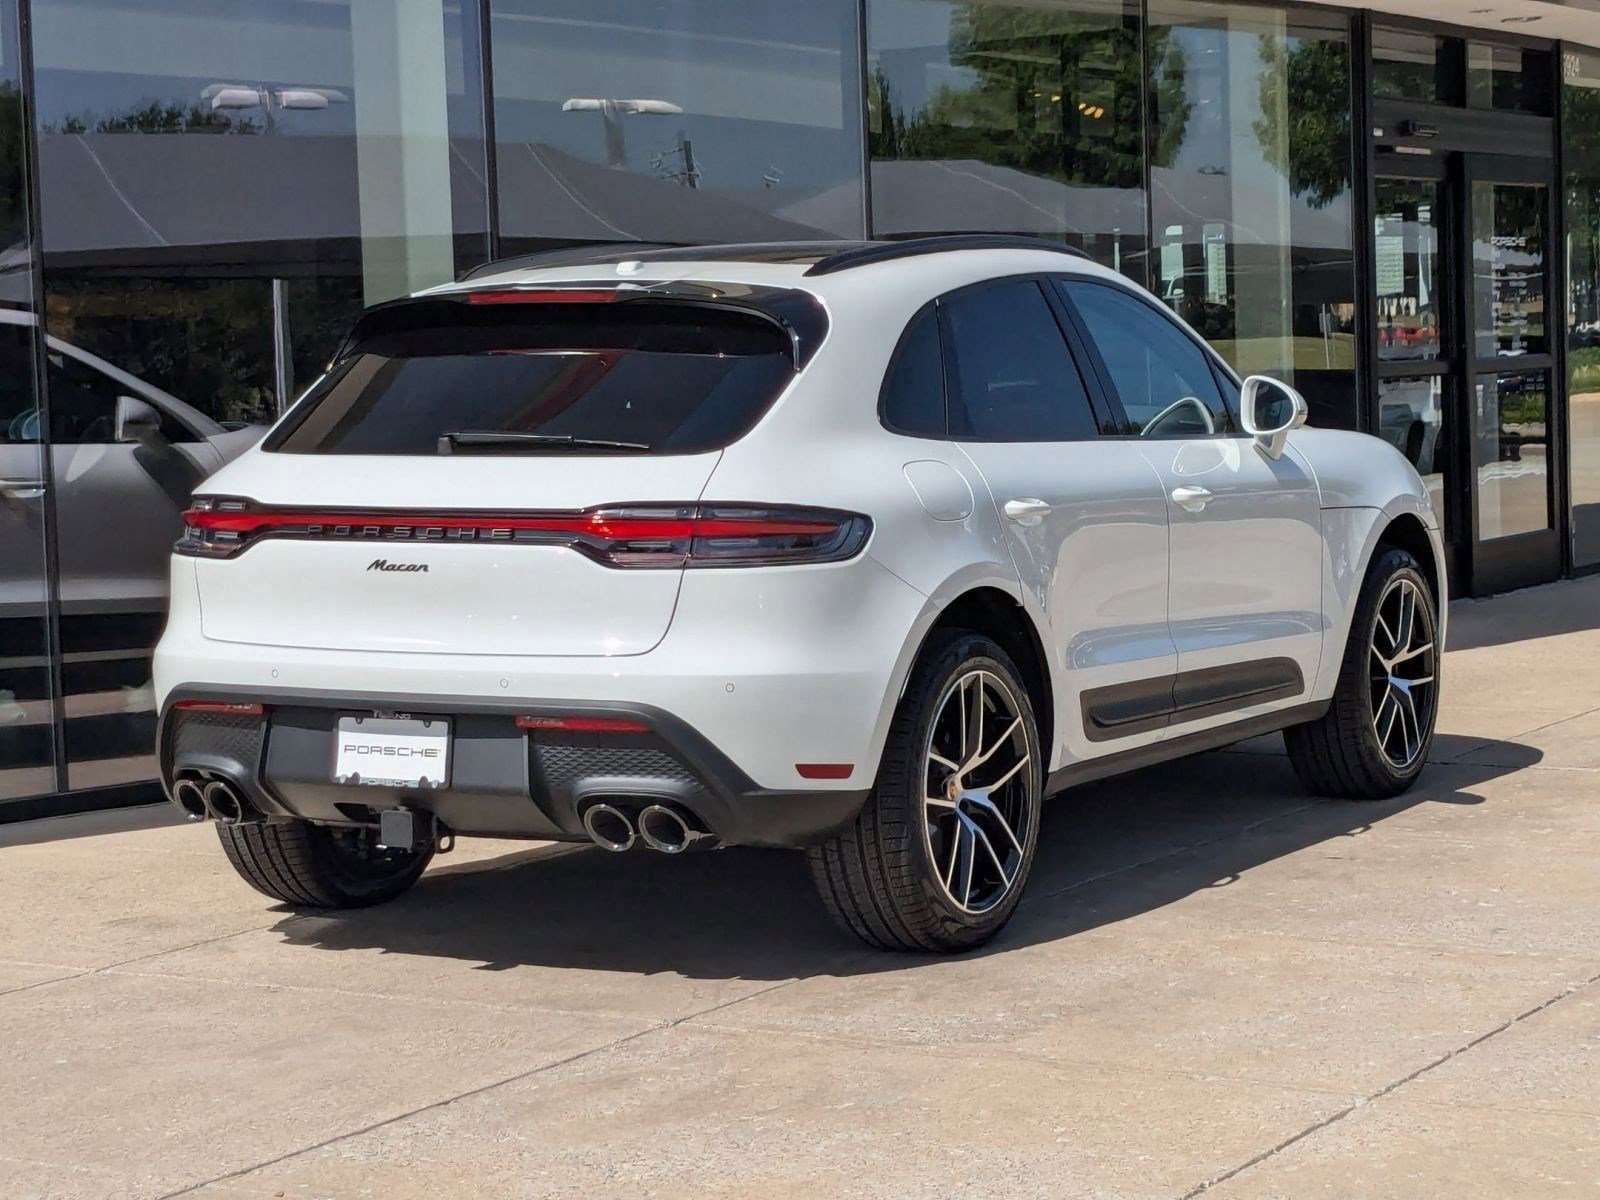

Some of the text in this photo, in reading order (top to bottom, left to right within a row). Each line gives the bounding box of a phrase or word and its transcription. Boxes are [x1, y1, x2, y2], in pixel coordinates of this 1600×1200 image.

[307, 525, 514, 540] PORSCHE
[366, 558, 429, 573] Macan
[344, 744, 439, 758] PORSCHE
